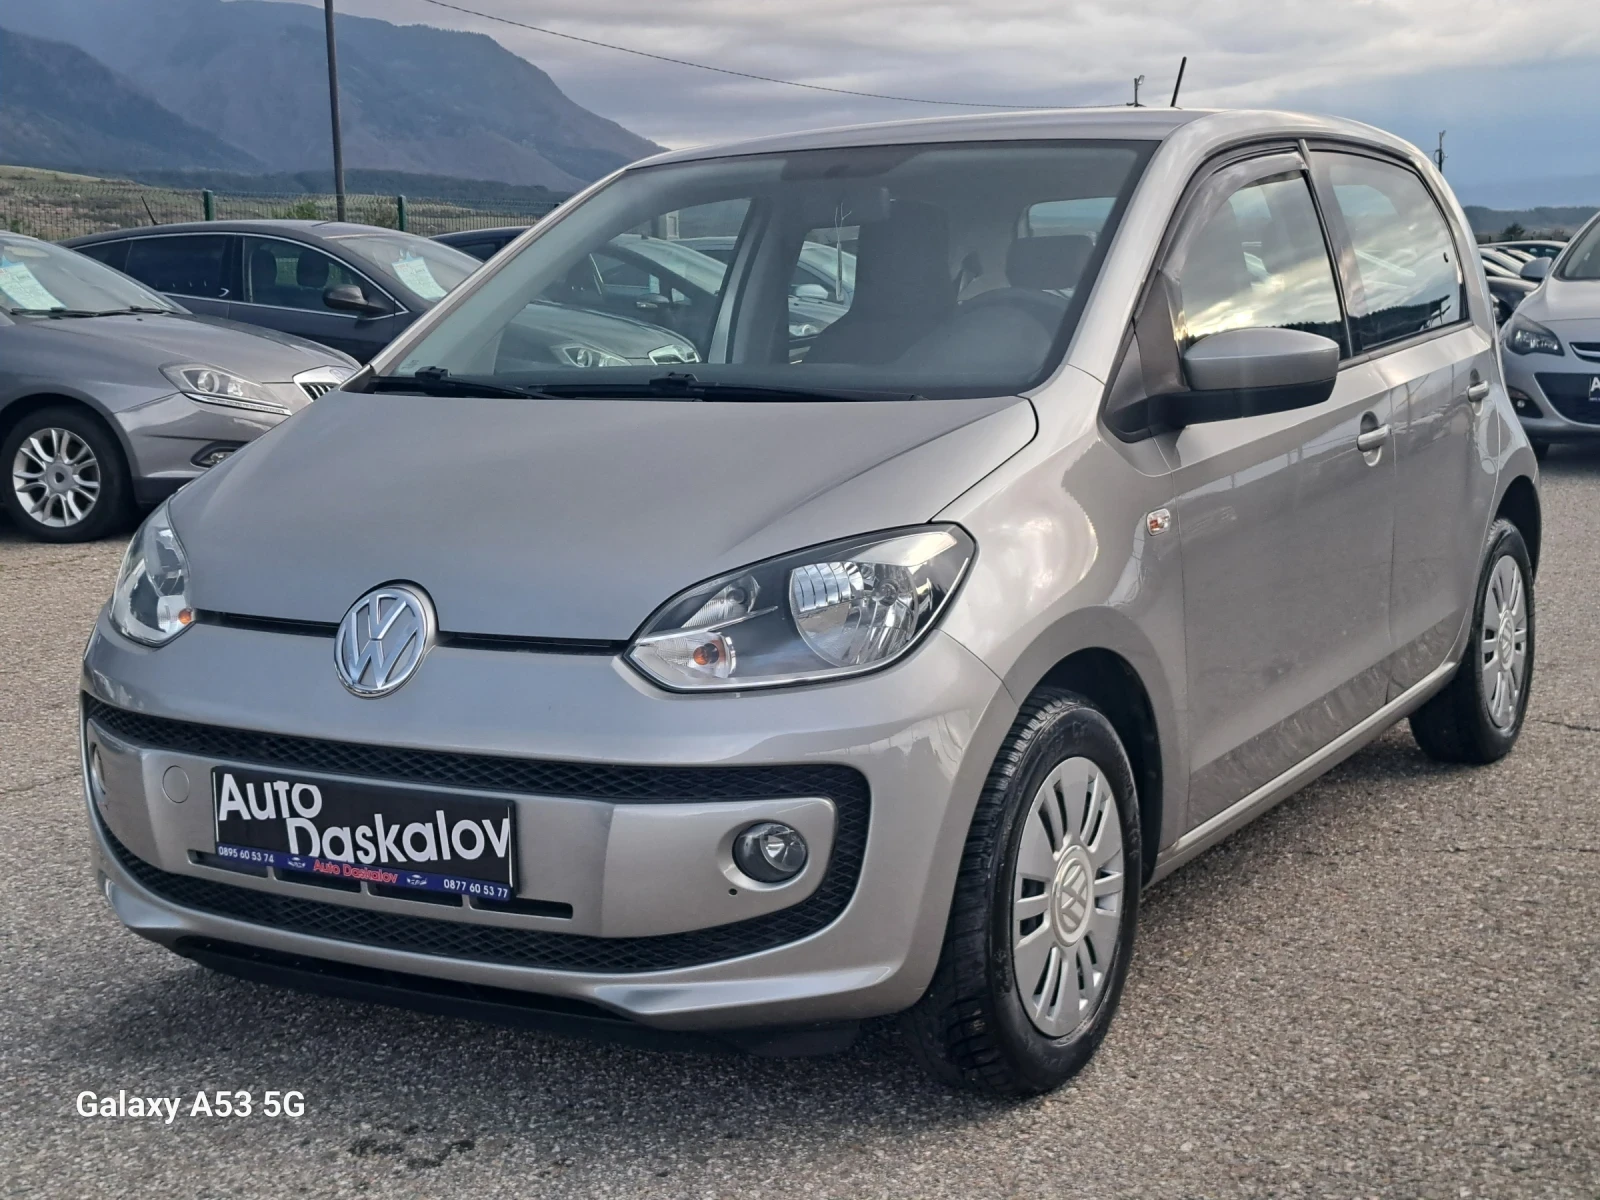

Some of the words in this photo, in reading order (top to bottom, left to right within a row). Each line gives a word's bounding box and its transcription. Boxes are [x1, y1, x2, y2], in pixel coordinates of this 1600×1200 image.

[218, 773, 323, 821] Auto
[285, 809, 510, 865] Daskalov
[218, 846, 238, 858] 0895
[240, 849, 250, 860] 60
[251, 852, 262, 861] 53
[263, 853, 274, 863] 74
[313, 859, 340, 874] Auto
[342, 863, 398, 883] Daskalov
[443, 879, 467, 891] 0877
[469, 883, 481, 893] 60
[483, 885, 495, 896] 53
[497, 887, 508, 898] 77
